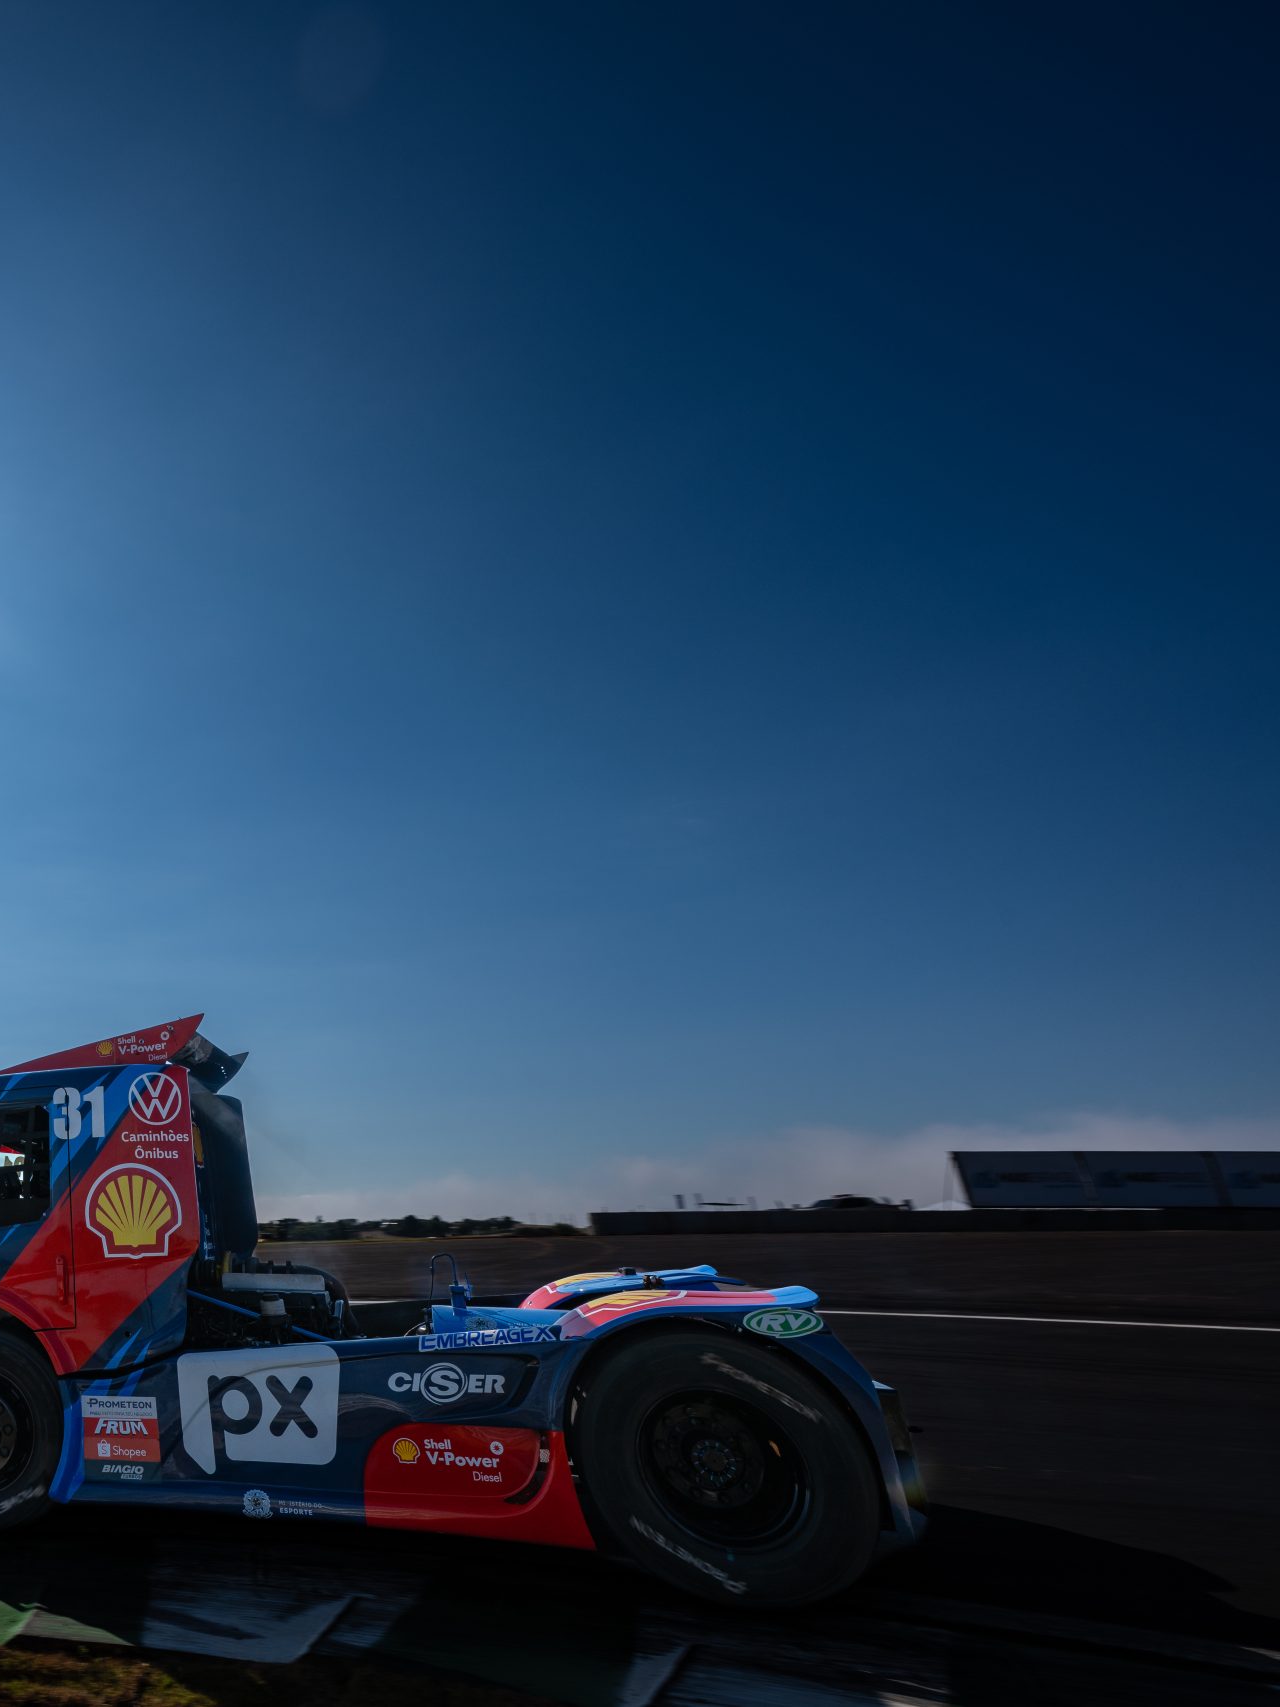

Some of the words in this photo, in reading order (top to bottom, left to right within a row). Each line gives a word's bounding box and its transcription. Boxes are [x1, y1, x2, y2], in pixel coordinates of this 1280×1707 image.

[118, 1036, 136, 1045] Shell
[118, 1042, 167, 1055] V-Power
[148, 1053, 168, 1061] Diesel
[52, 1086, 106, 1140] 31
[121, 1130, 189, 1142] Caminhões
[134, 1145, 179, 1159] Ônibus
[759, 1314, 808, 1331] RV
[420, 1326, 556, 1350] EMBREAGEX
[387, 1365, 506, 1400] CISER
[87, 1398, 152, 1409] PROMETEON
[207, 1375, 318, 1462] px
[94, 1418, 148, 1435] FRUM
[423, 1439, 451, 1450] Shell
[112, 1445, 147, 1459] Shopee
[426, 1451, 500, 1468] V-Power
[102, 1464, 144, 1474] BIAGIO
[473, 1471, 503, 1483] Diesel
[280, 1507, 313, 1516] ESPORTE
